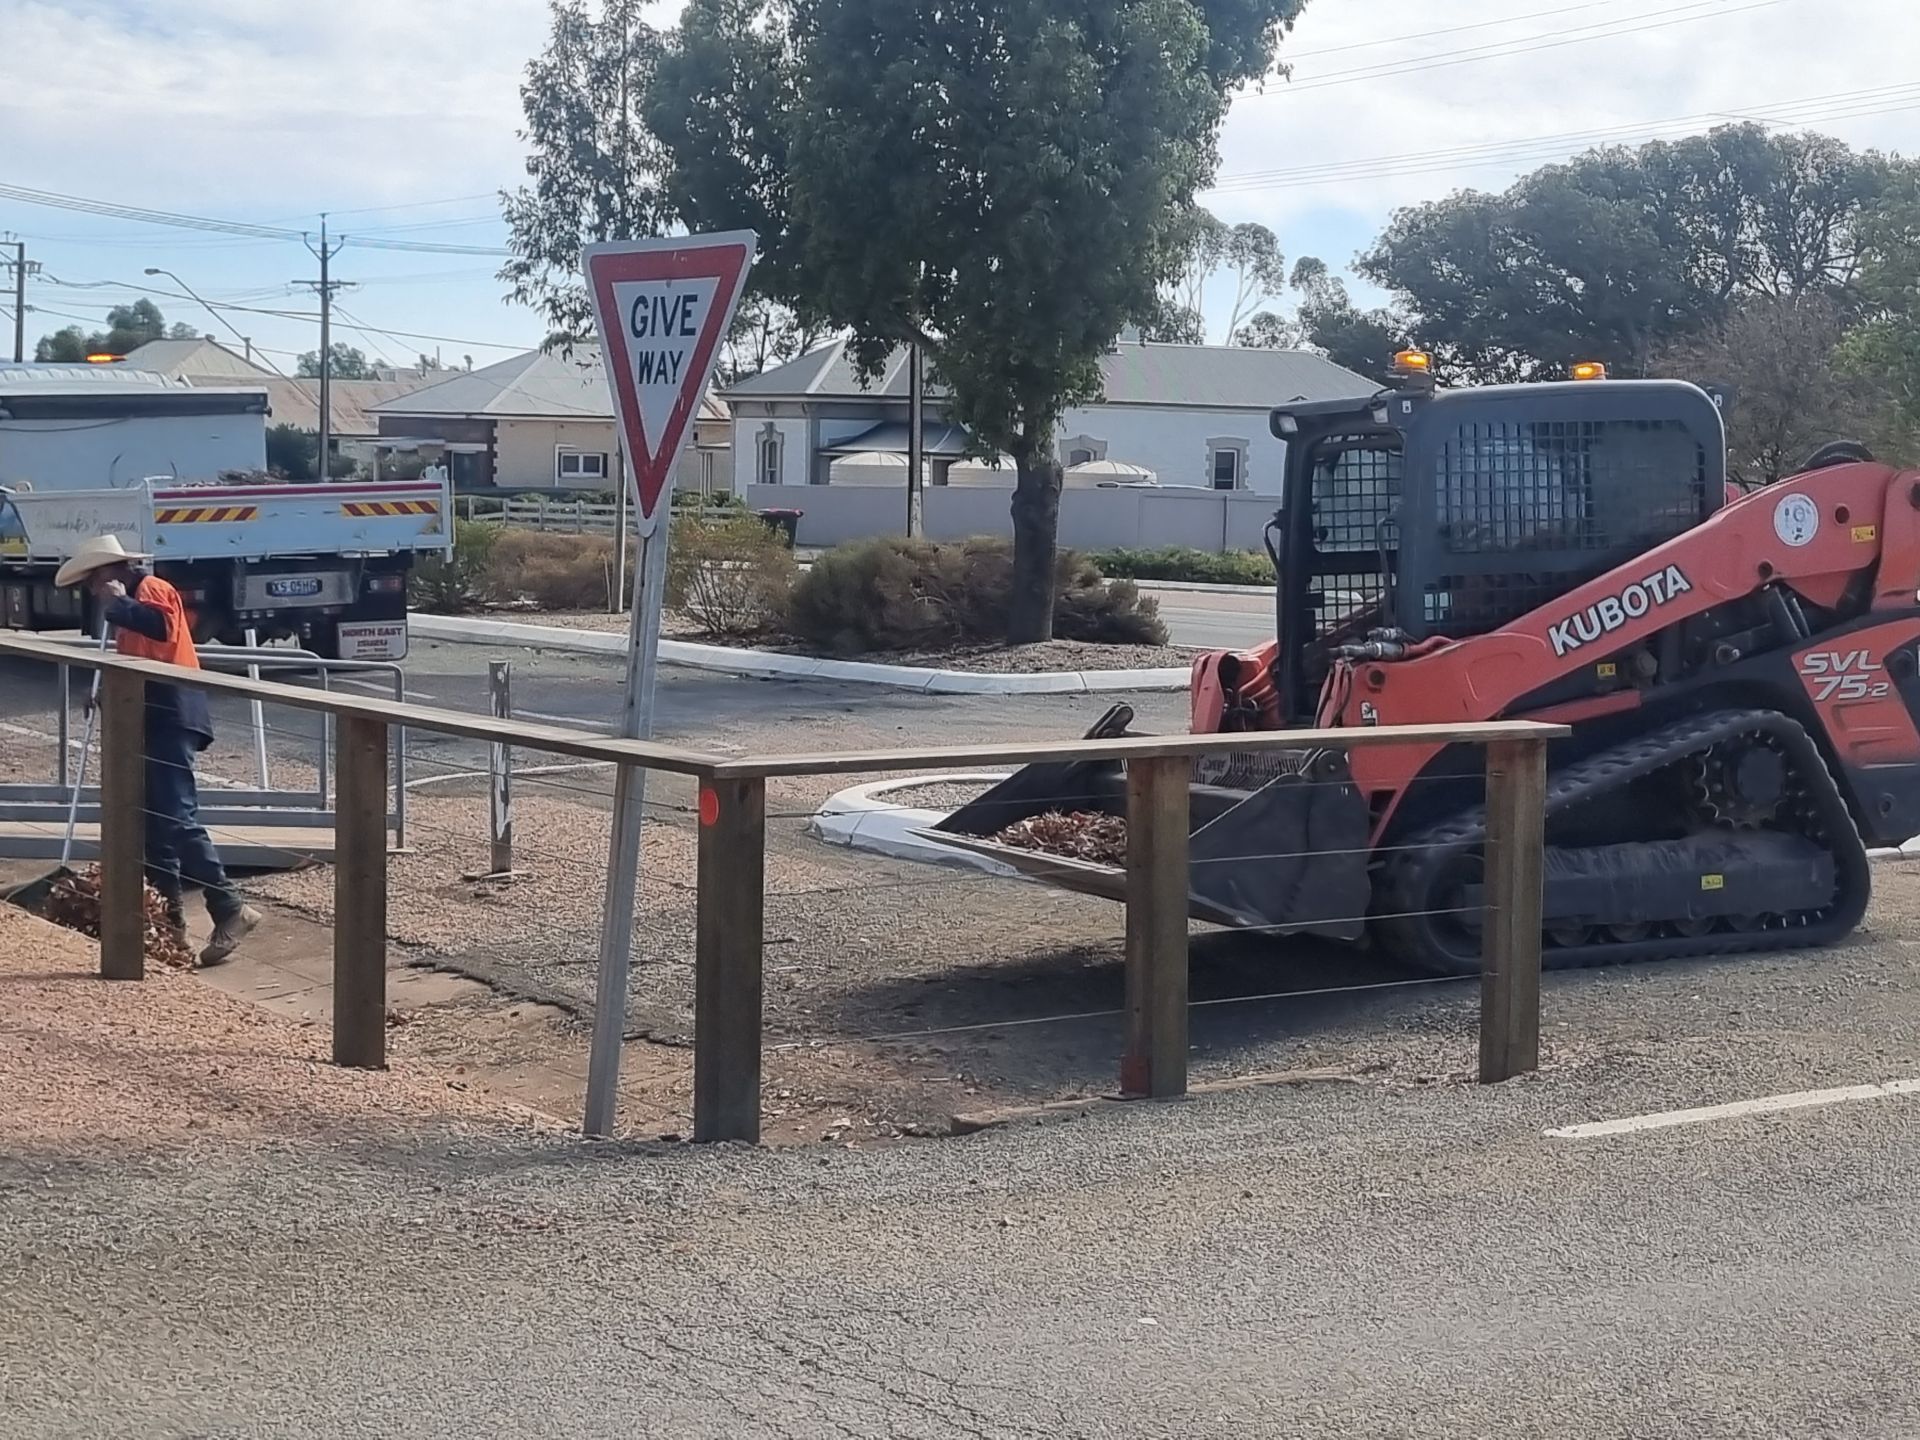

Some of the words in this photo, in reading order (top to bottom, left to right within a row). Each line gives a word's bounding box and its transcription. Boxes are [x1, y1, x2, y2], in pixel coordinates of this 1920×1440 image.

[630, 294, 698, 338] GIVE
[638, 350, 683, 385] WAY
[1548, 564, 1692, 657] KUBOTA
[341, 628, 376, 637] NORTH
[377, 627, 403, 636] EAST
[1800, 649, 1882, 675] SVL
